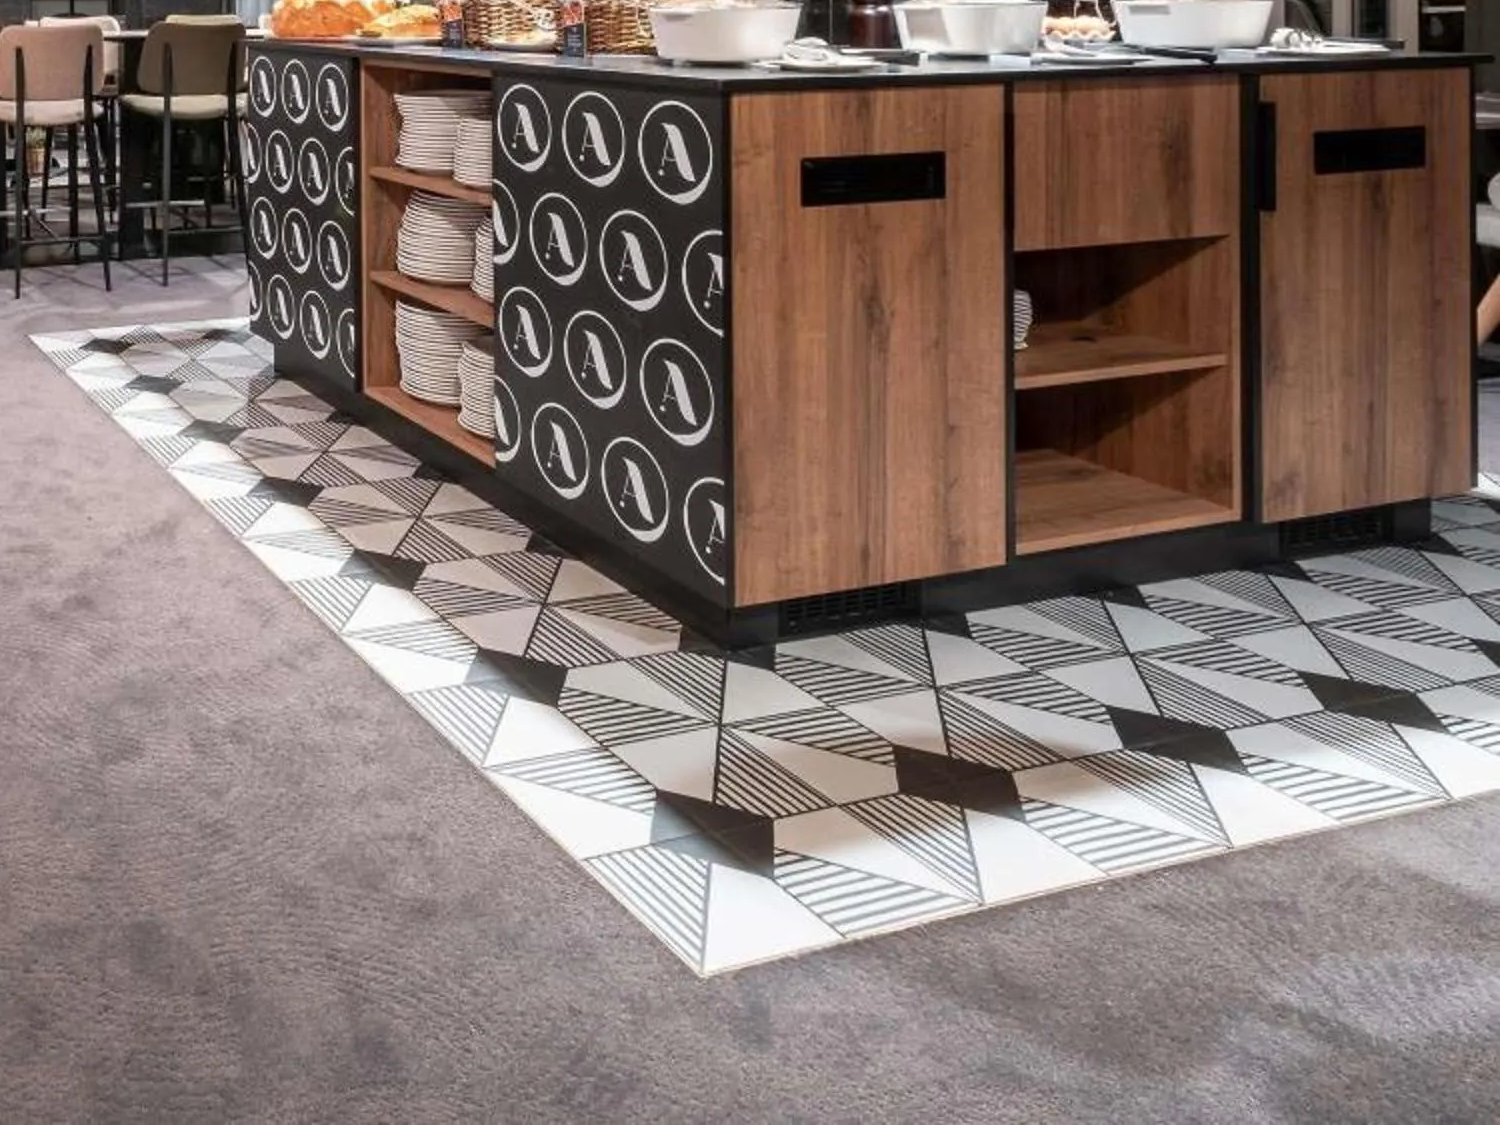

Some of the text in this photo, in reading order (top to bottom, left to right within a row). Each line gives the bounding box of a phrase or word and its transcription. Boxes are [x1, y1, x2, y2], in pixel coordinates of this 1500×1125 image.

[257, 69, 271, 104] A
[289, 74, 305, 111] A
[324, 78, 342, 117] A
[512, 103, 540, 153] A
[579, 112, 611, 166] A
[274, 144, 289, 180] A
[307, 152, 323, 191] A
[658, 122, 696, 182] A
[258, 210, 272, 246] A
[290, 222, 305, 260] A
[546, 213, 574, 268] A
[326, 235, 343, 277] A
[618, 230, 652, 291] A
[274, 287, 289, 326] A
[308, 305, 325, 346] A
[514, 305, 541, 359] A
[581, 330, 613, 390] A
[660, 359, 697, 426] A
[547, 420, 576, 481] A
[620, 457, 654, 524] A
